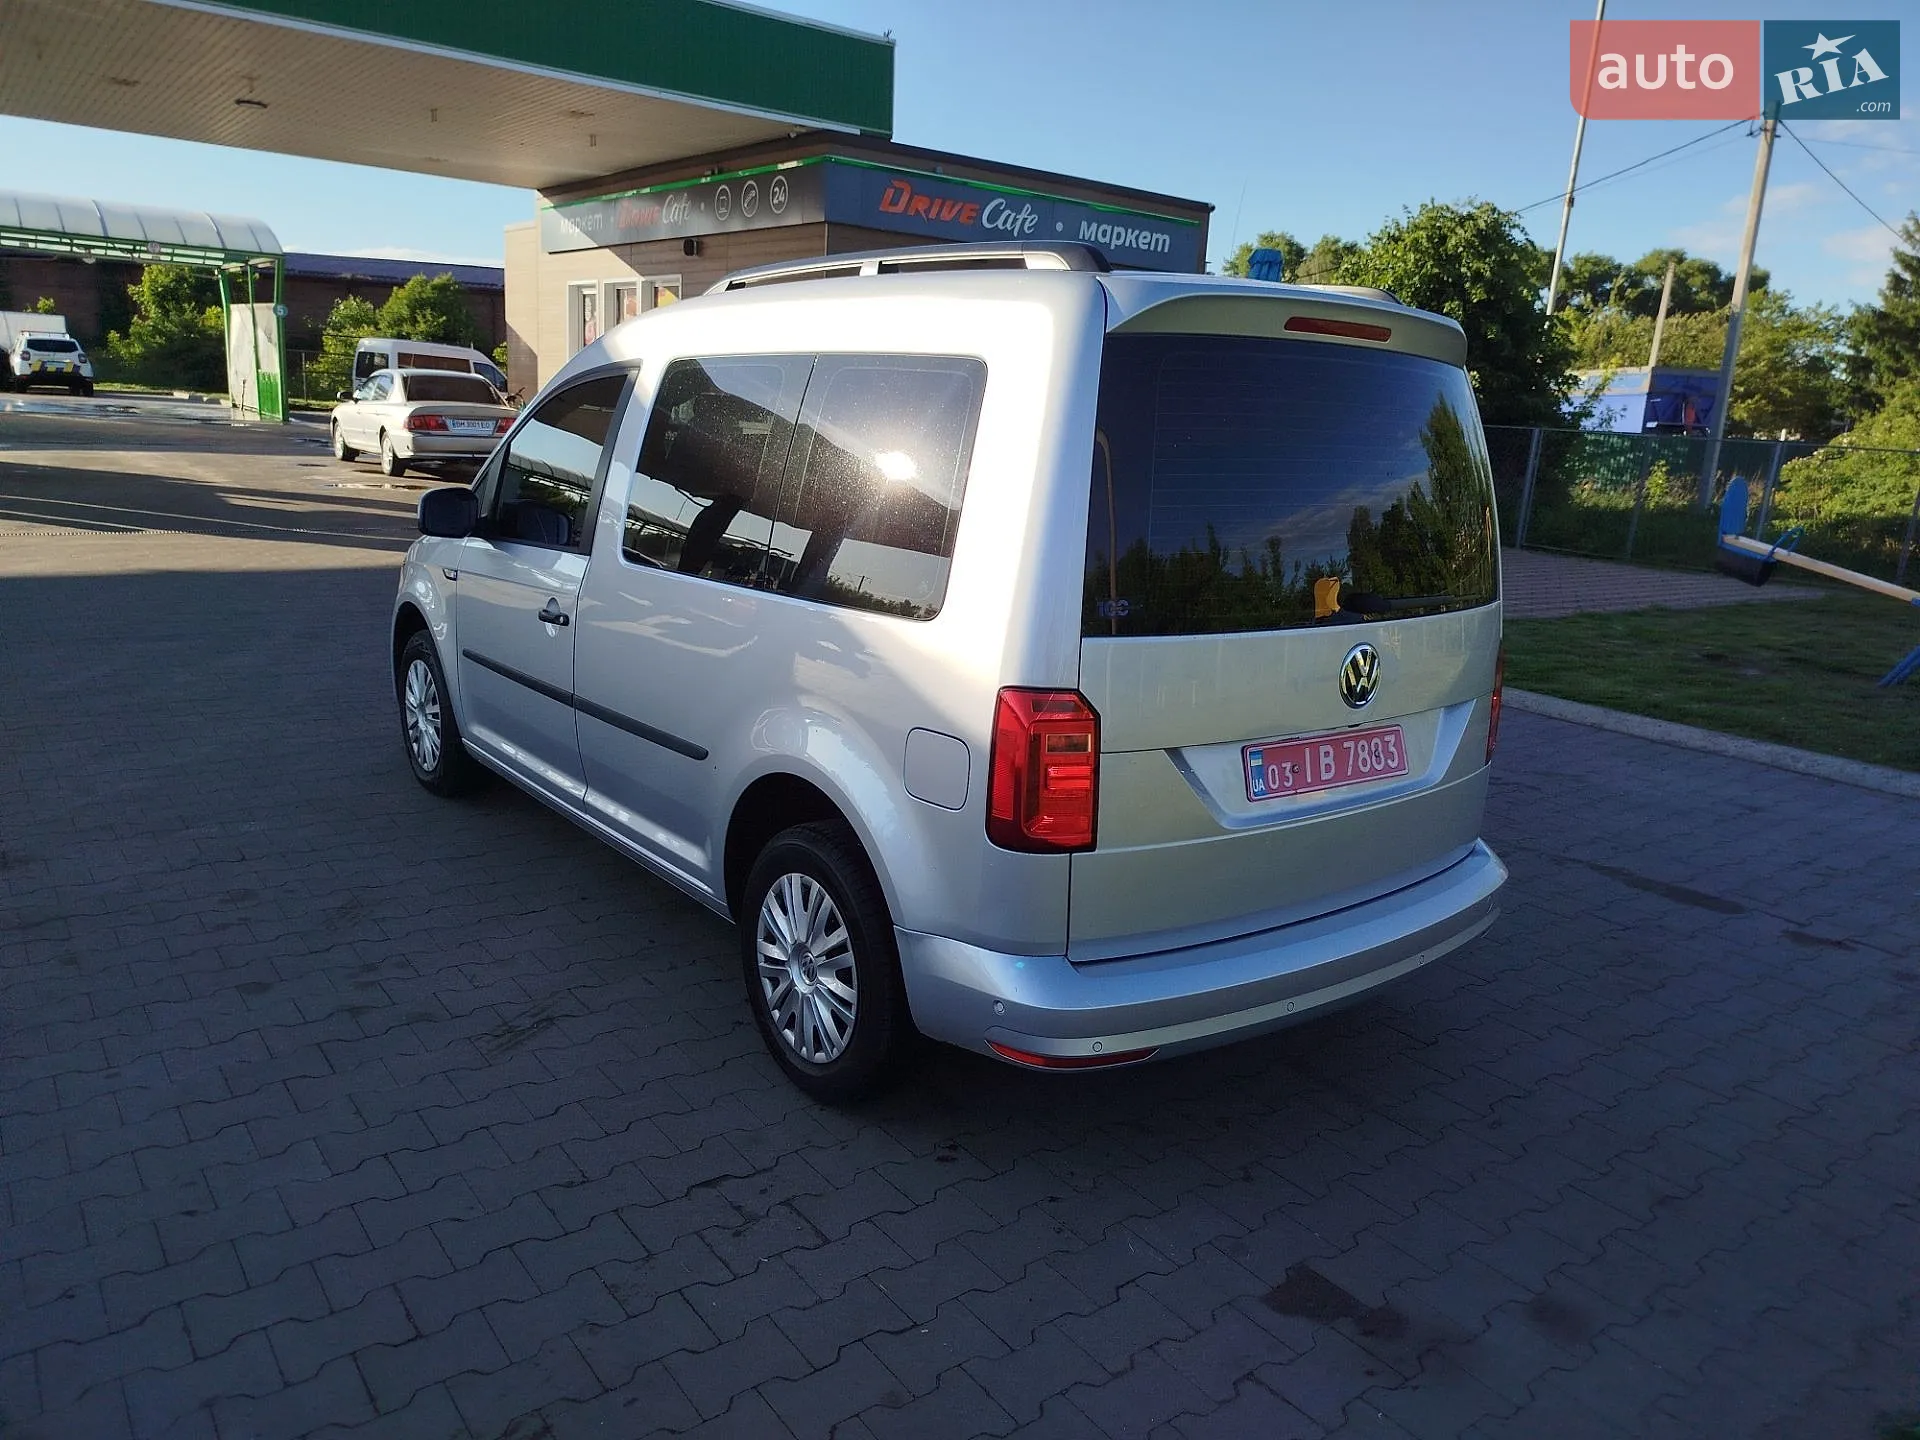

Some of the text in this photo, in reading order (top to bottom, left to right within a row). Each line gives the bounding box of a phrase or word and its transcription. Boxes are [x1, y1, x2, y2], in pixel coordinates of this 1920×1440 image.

[773, 185, 785, 205] 24
[981, 198, 1040, 240] Cafe
[1078, 220, 1172, 254] маркет
[1267, 760, 1293, 790] 03
[1303, 744, 1336, 784] IB
[1252, 779, 1266, 793] UA
